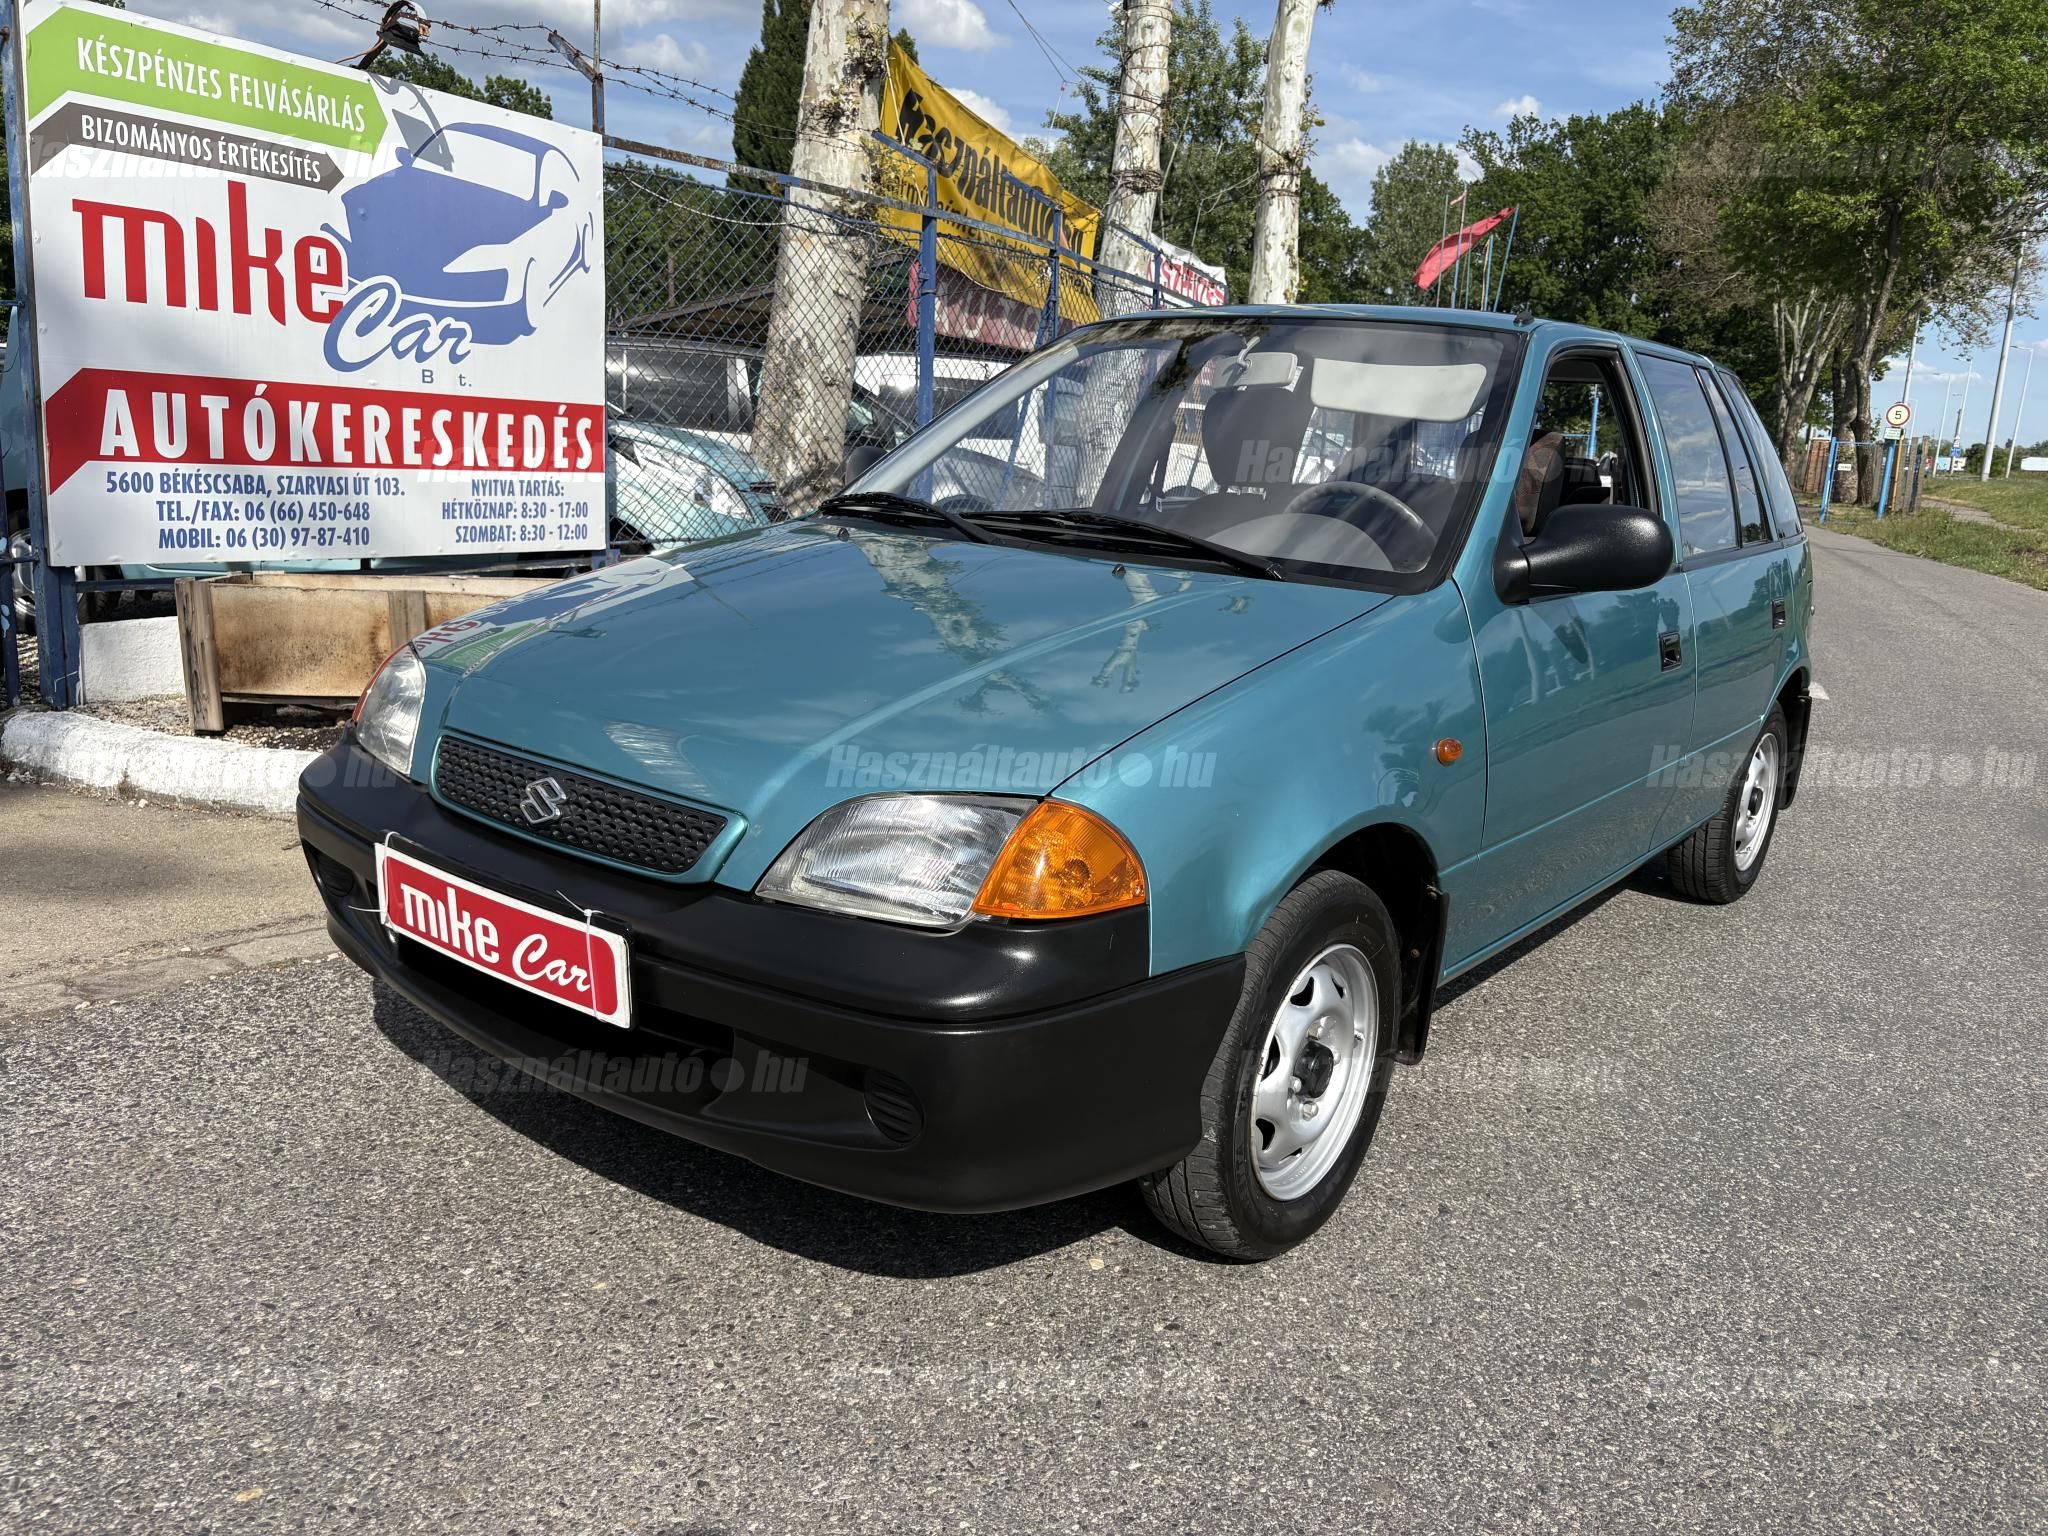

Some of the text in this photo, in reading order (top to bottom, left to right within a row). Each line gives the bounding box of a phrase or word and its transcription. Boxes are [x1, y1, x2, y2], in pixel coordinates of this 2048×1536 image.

[77, 35, 365, 132] KÉSZPÉNZES FELVÁSÁRLÁS
[81, 114, 321, 183] BIZOMÁNYOS ÉRTÉKESÍTÉS
[72, 180, 346, 327] mike
[323, 281, 471, 373] Car
[100, 384, 594, 471] AUTÓKERESKEDÉS
[1894, 410, 1902, 420] 5
[106, 468, 405, 498] 5600 BÉKÉSCSABA, SZARVASI ÚT 103.
[472, 476, 564, 496] NYITVA TARTÁS:
[157, 500, 370, 525] TEL./FAX: 06 (66) 450-648
[442, 498, 517, 520] HÉTKÖZNAP:
[521, 502, 546, 518] 8:30
[558, 502, 588, 518] 17:00
[159, 527, 370, 550] MOBIL: 06 (30) 97-87-410
[455, 525, 516, 543] SZOMBAT:
[520, 525, 545, 541] 8:30
[557, 524, 588, 540] 12:00
[400, 883, 591, 992] mike Car
